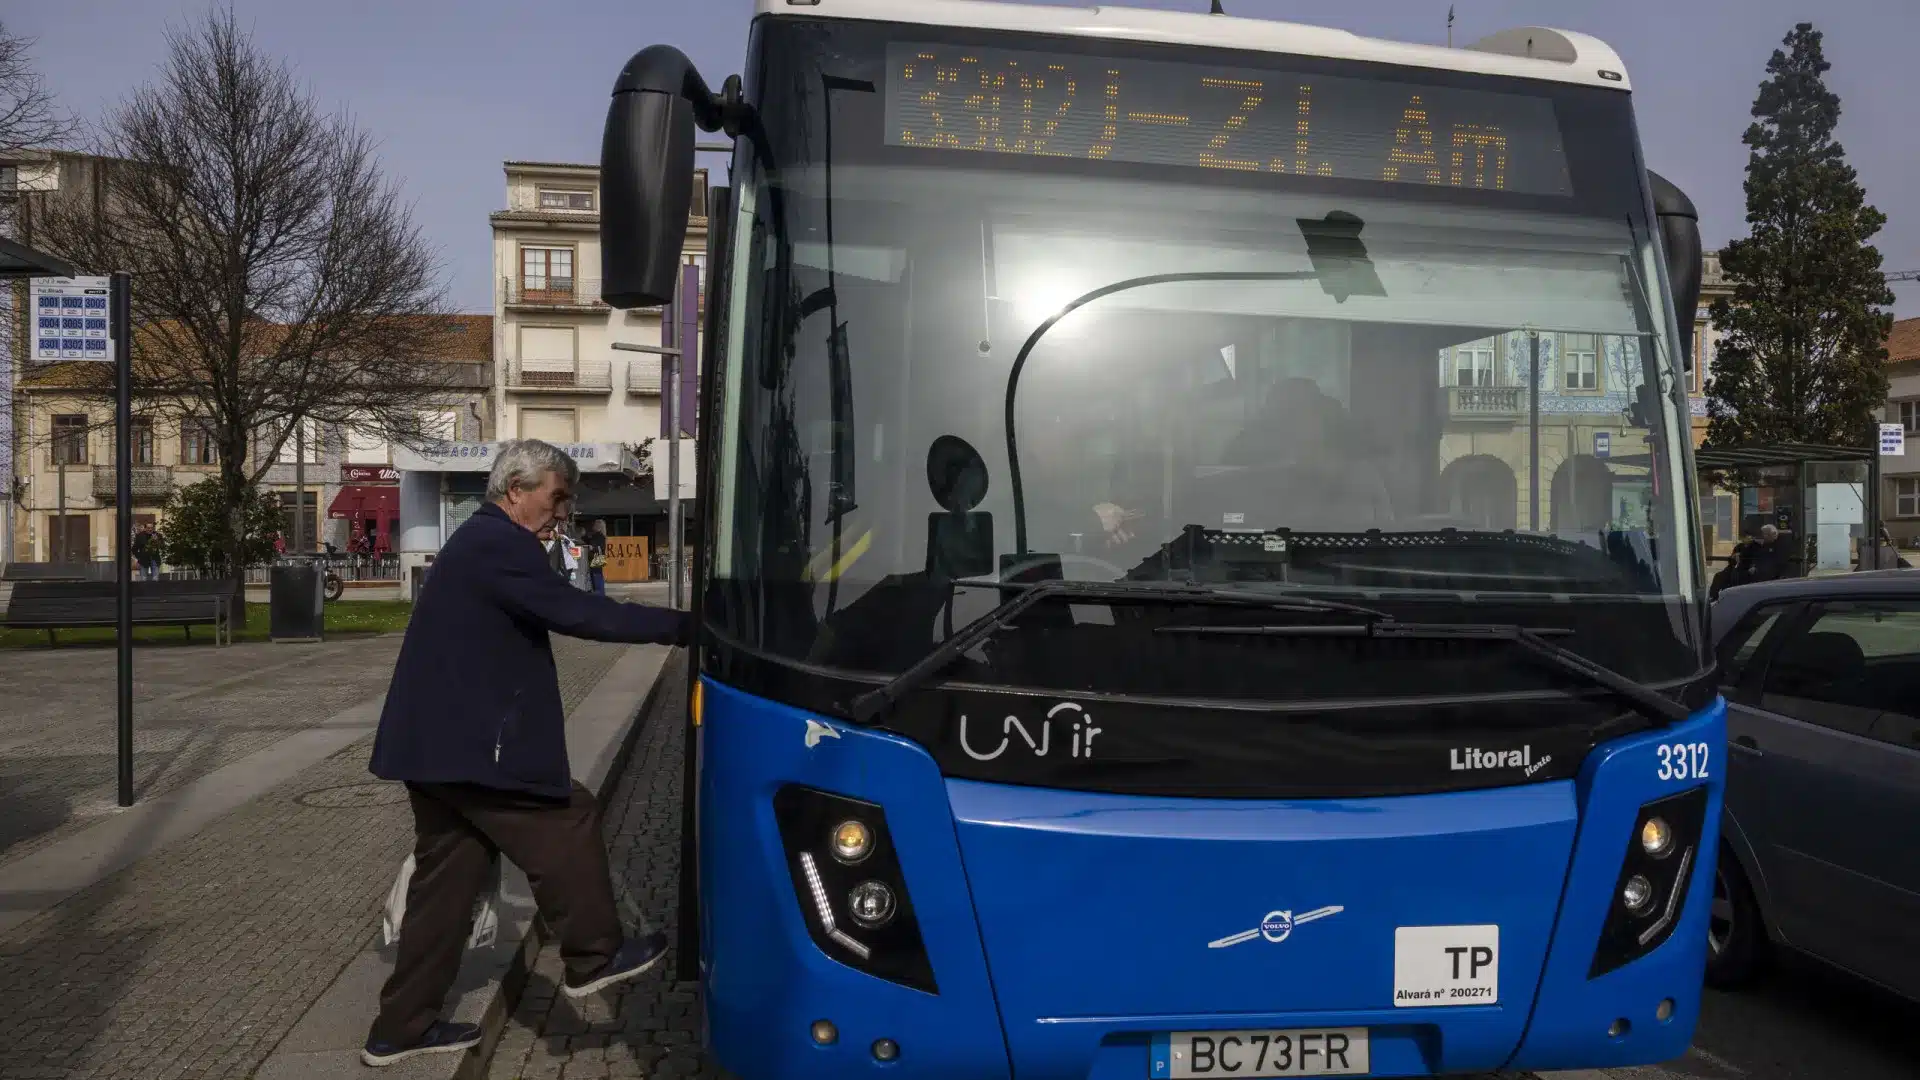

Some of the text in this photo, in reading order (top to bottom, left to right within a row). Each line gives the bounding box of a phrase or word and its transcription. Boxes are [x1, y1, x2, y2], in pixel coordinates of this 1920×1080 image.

[902, 53, 1076, 157] 3302
[1383, 95, 1507, 189] Am
[39, 297, 58, 307] 3001
[62, 297, 82, 308] 3002
[85, 298, 106, 308] 3003
[606, 543, 642, 559] RAÇA
[1450, 745, 1530, 770] Litoral
[1657, 743, 1709, 781] 3312
[1444, 946, 1493, 979] TP
[1396, 988, 1431, 1000] Alvará
[1450, 987, 1492, 997] 200271
[1156, 1061, 1164, 1072] P
